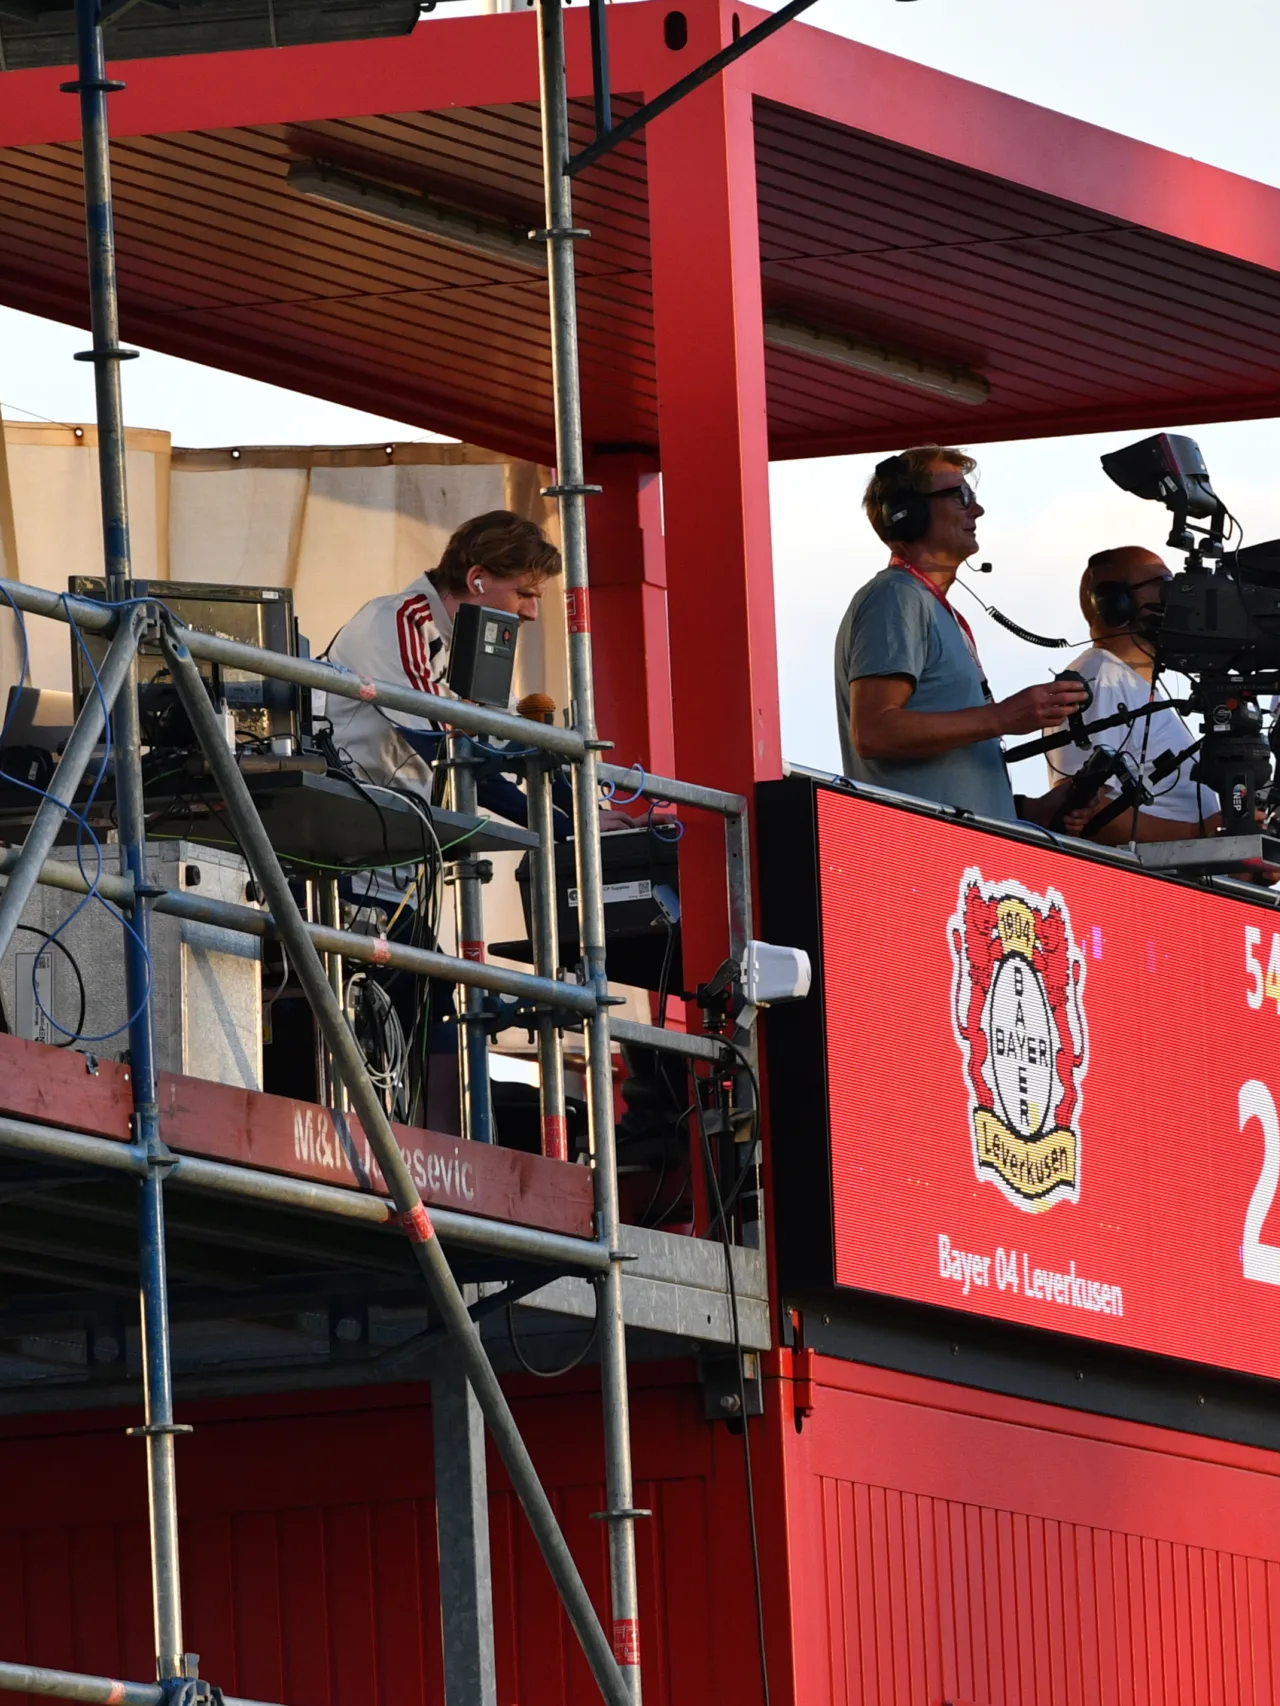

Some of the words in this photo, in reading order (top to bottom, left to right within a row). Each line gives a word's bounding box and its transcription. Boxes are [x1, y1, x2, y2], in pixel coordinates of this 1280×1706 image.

[1232, 791, 1243, 812] NEP
[1000, 910, 1031, 948] 1904
[995, 1028, 1049, 1068] BAYER
[1013, 967, 1030, 1126] BAYER
[982, 1121, 1068, 1184] Leverkusen
[937, 1233, 991, 1295] Bayer
[995, 1246, 1020, 1293] 04
[1023, 1252, 1124, 1317] Leverkusen
